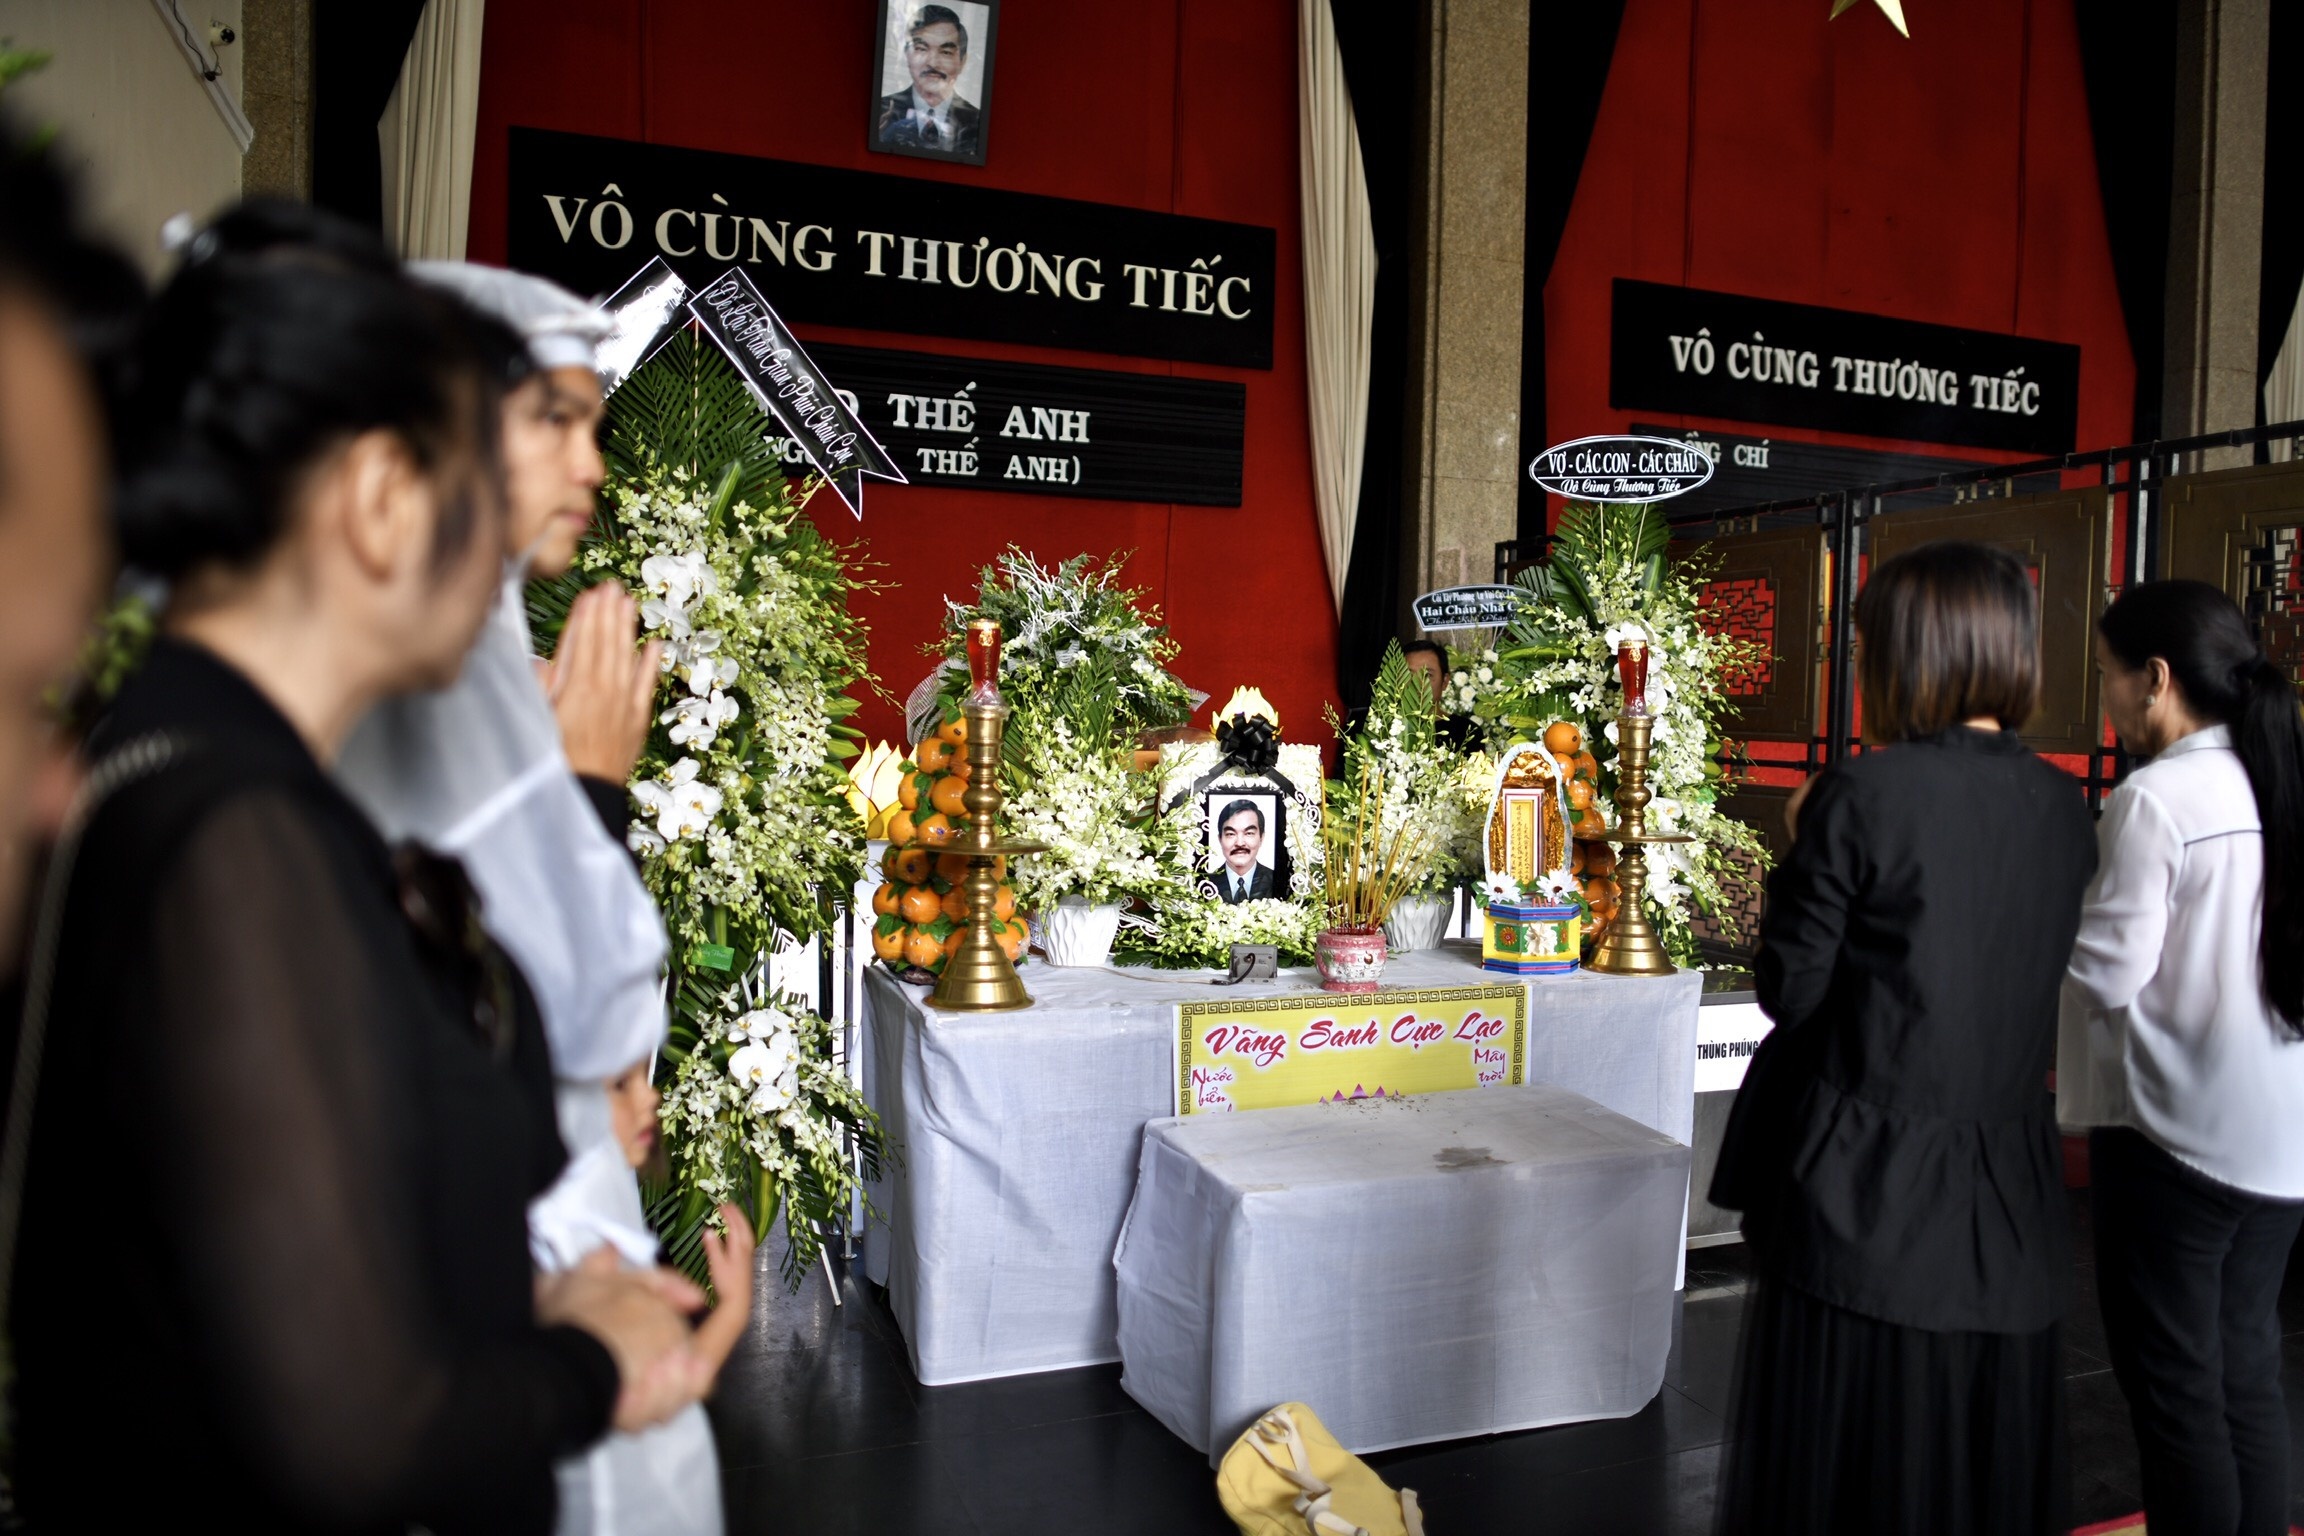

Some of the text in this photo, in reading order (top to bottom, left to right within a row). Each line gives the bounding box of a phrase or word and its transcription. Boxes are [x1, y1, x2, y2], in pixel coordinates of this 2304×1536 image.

[542, 182, 1252, 320] VÔ CÙNG THƯƠNG TIẾC
[1669, 328, 2041, 416] VÔ CÙNG THƯƠNG TIẾC
[759, 348, 793, 386] Gian
[804, 405, 839, 444] Cháu
[886, 381, 977, 433] THẾ
[999, 405, 1091, 443] ANH
[916, 436, 979, 476] THẾ
[1003, 455, 1081, 485] ANH)
[1548, 451, 1567, 477] VỢ
[1575, 449, 1601, 473] CÁC
[1603, 452, 1630, 473] CON
[1639, 449, 1663, 473] CÁC
[1665, 449, 1698, 473] CHÁU
[1733, 439, 1769, 468] CHÍ
[1561, 478, 1579, 493] Vô
[1582, 478, 1610, 495] Cùng
[1613, 478, 1655, 495] Thương
[1422, 604, 1443, 617] Hai
[1445, 602, 1477, 615] Cháu
[1205, 1012, 1505, 1067] Vãng Sanh Cực Lạc
[1697, 1040, 1727, 1060] THÙNG
[1474, 1048, 1506, 1074] Mây
[1192, 1066, 1233, 1086] Nước
[1478, 1070, 1503, 1082] trời
